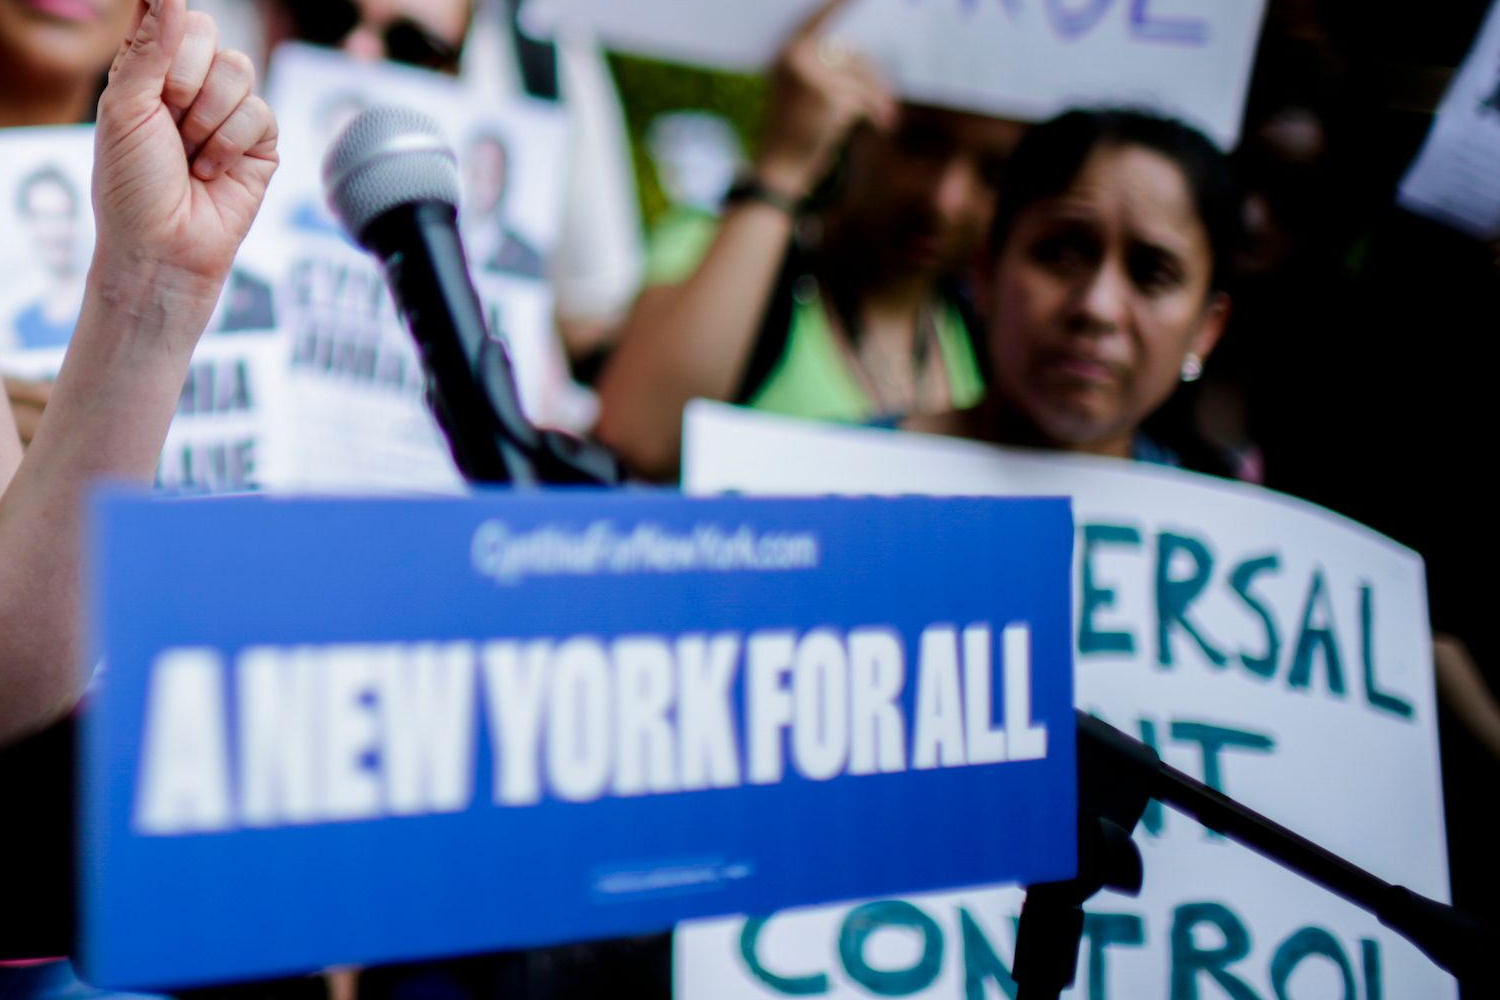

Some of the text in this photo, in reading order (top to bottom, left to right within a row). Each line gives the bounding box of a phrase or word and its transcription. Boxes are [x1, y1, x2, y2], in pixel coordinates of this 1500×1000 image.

[1076, 522, 1418, 724] ERSAL
[133, 620, 1049, 836] A NEW YORK FOR ALL
